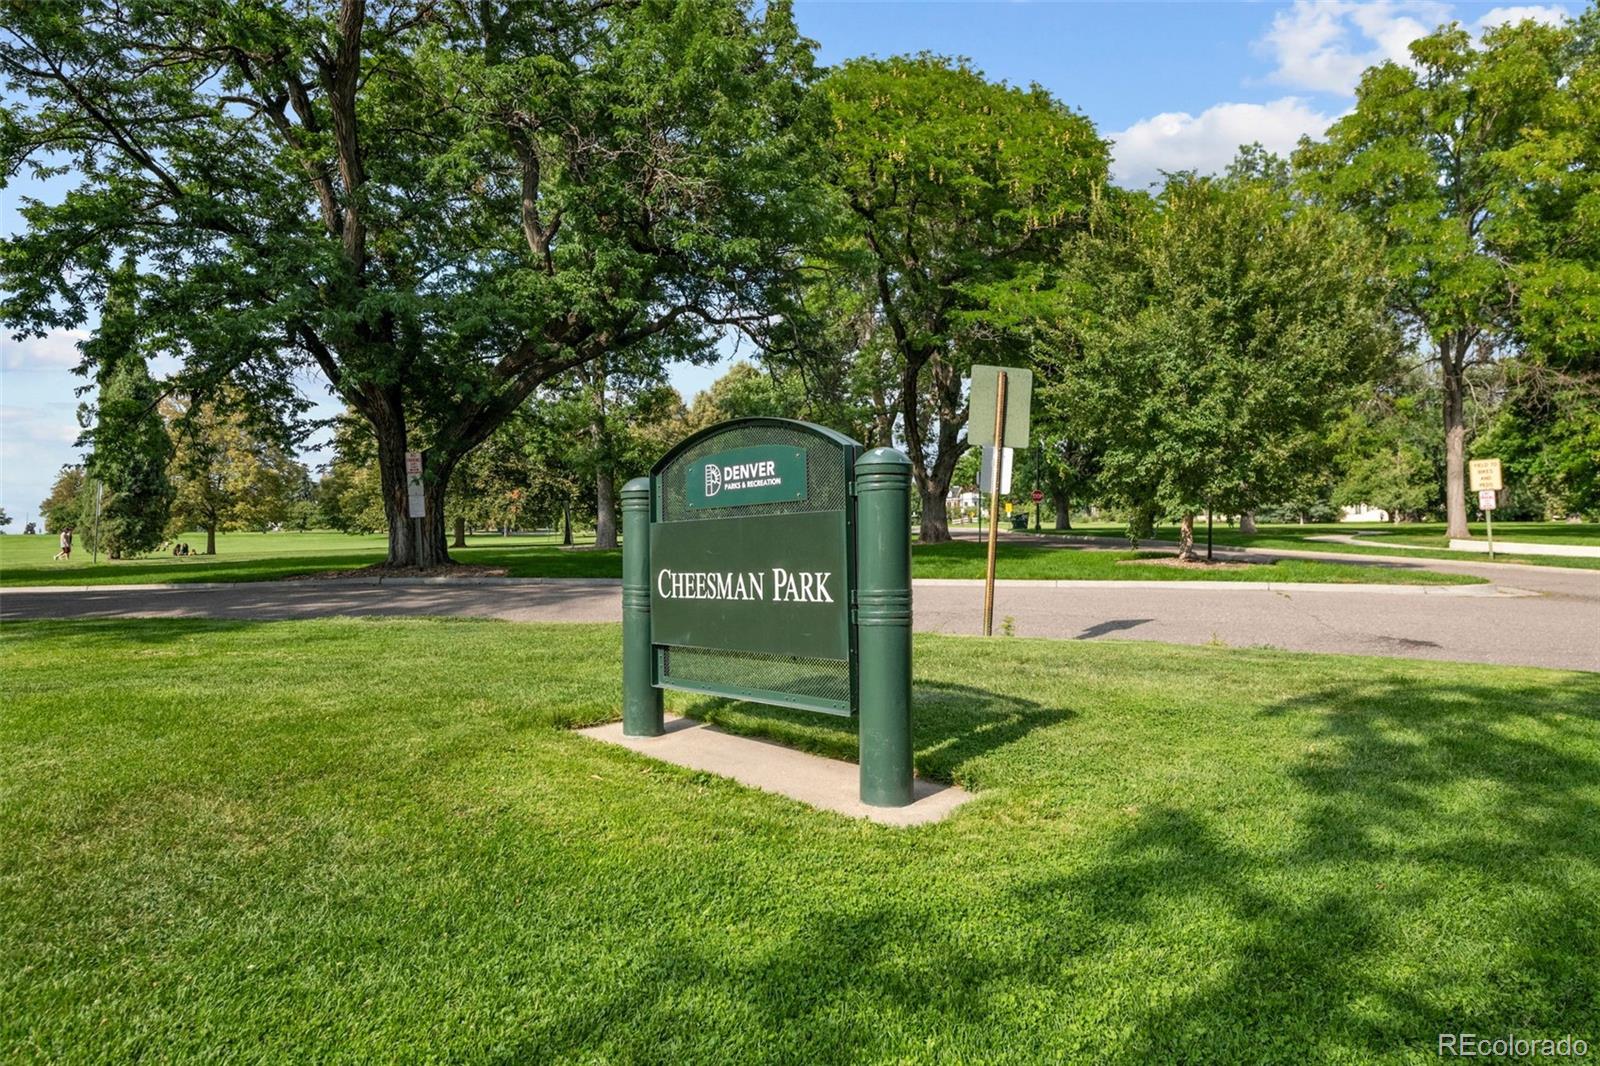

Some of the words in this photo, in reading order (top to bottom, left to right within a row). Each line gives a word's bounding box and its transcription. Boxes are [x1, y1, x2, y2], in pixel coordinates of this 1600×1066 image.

[724, 461, 775, 480] DENVER
[724, 482, 741, 490] PARKS
[747, 478, 781, 489] RECREATION
[658, 568, 764, 600] CHEESMAN
[772, 568, 834, 602] PARK
